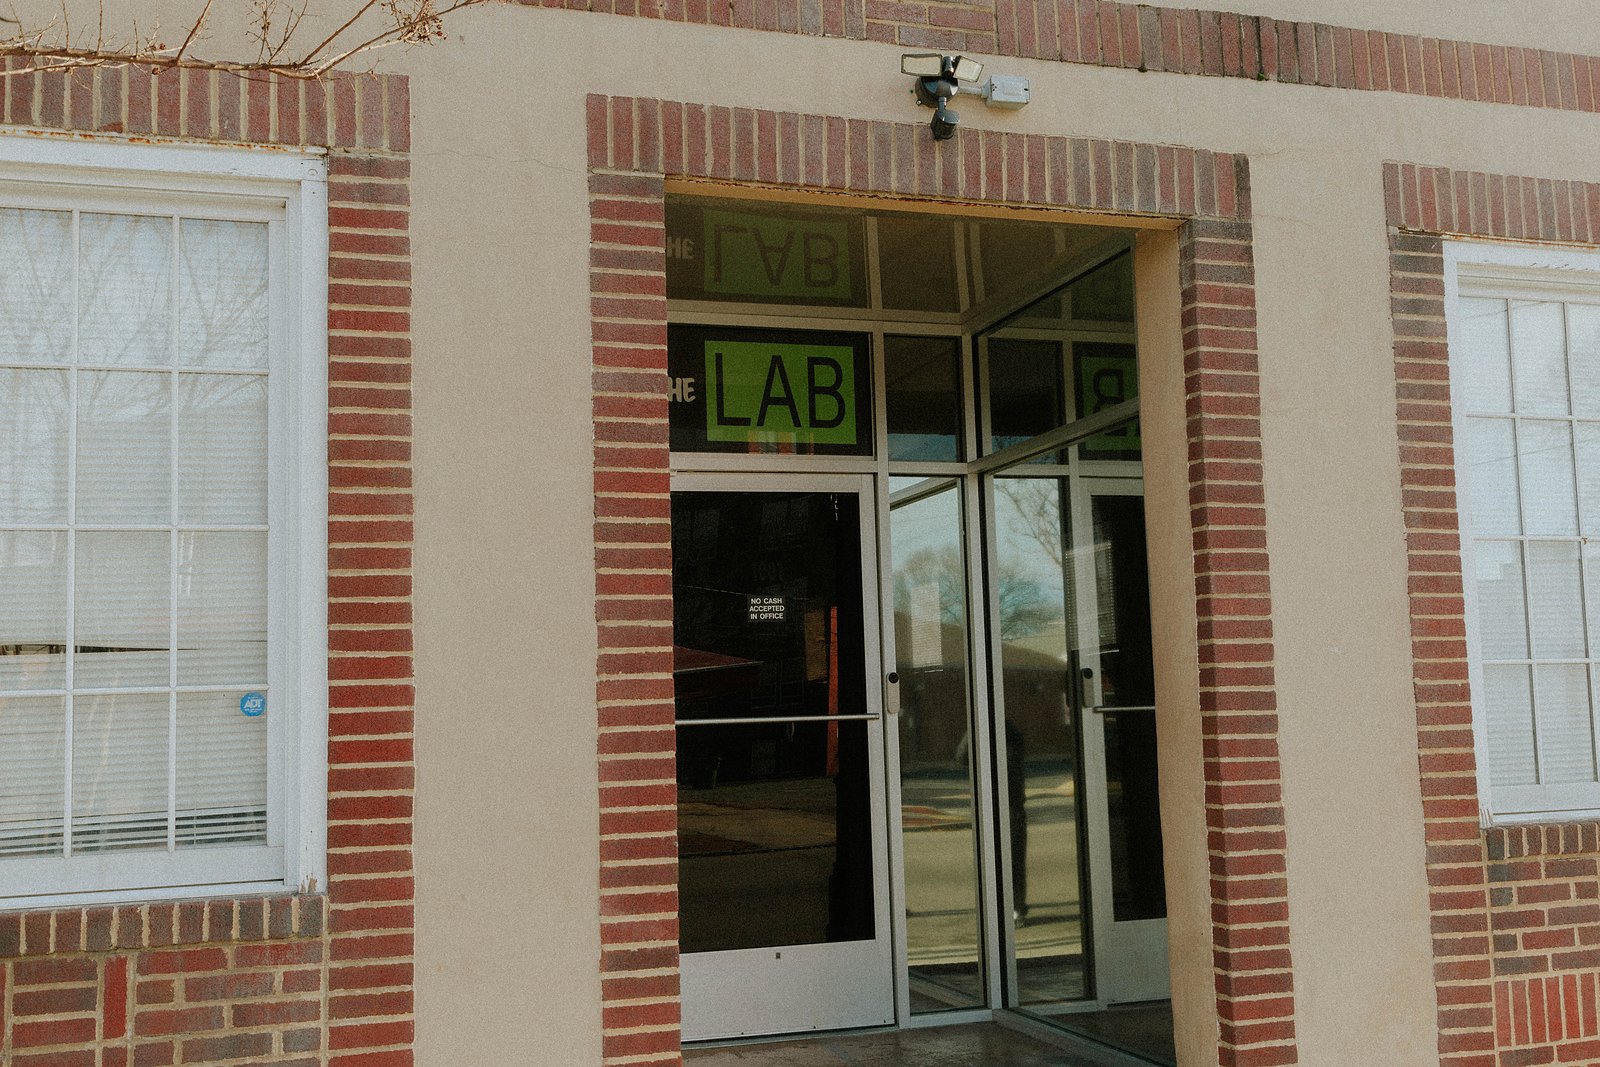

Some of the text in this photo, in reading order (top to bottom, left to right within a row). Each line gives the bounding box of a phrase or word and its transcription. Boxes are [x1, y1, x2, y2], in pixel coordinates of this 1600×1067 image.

[667, 352, 846, 429] HE LAB
[243, 698, 263, 708] ADT
